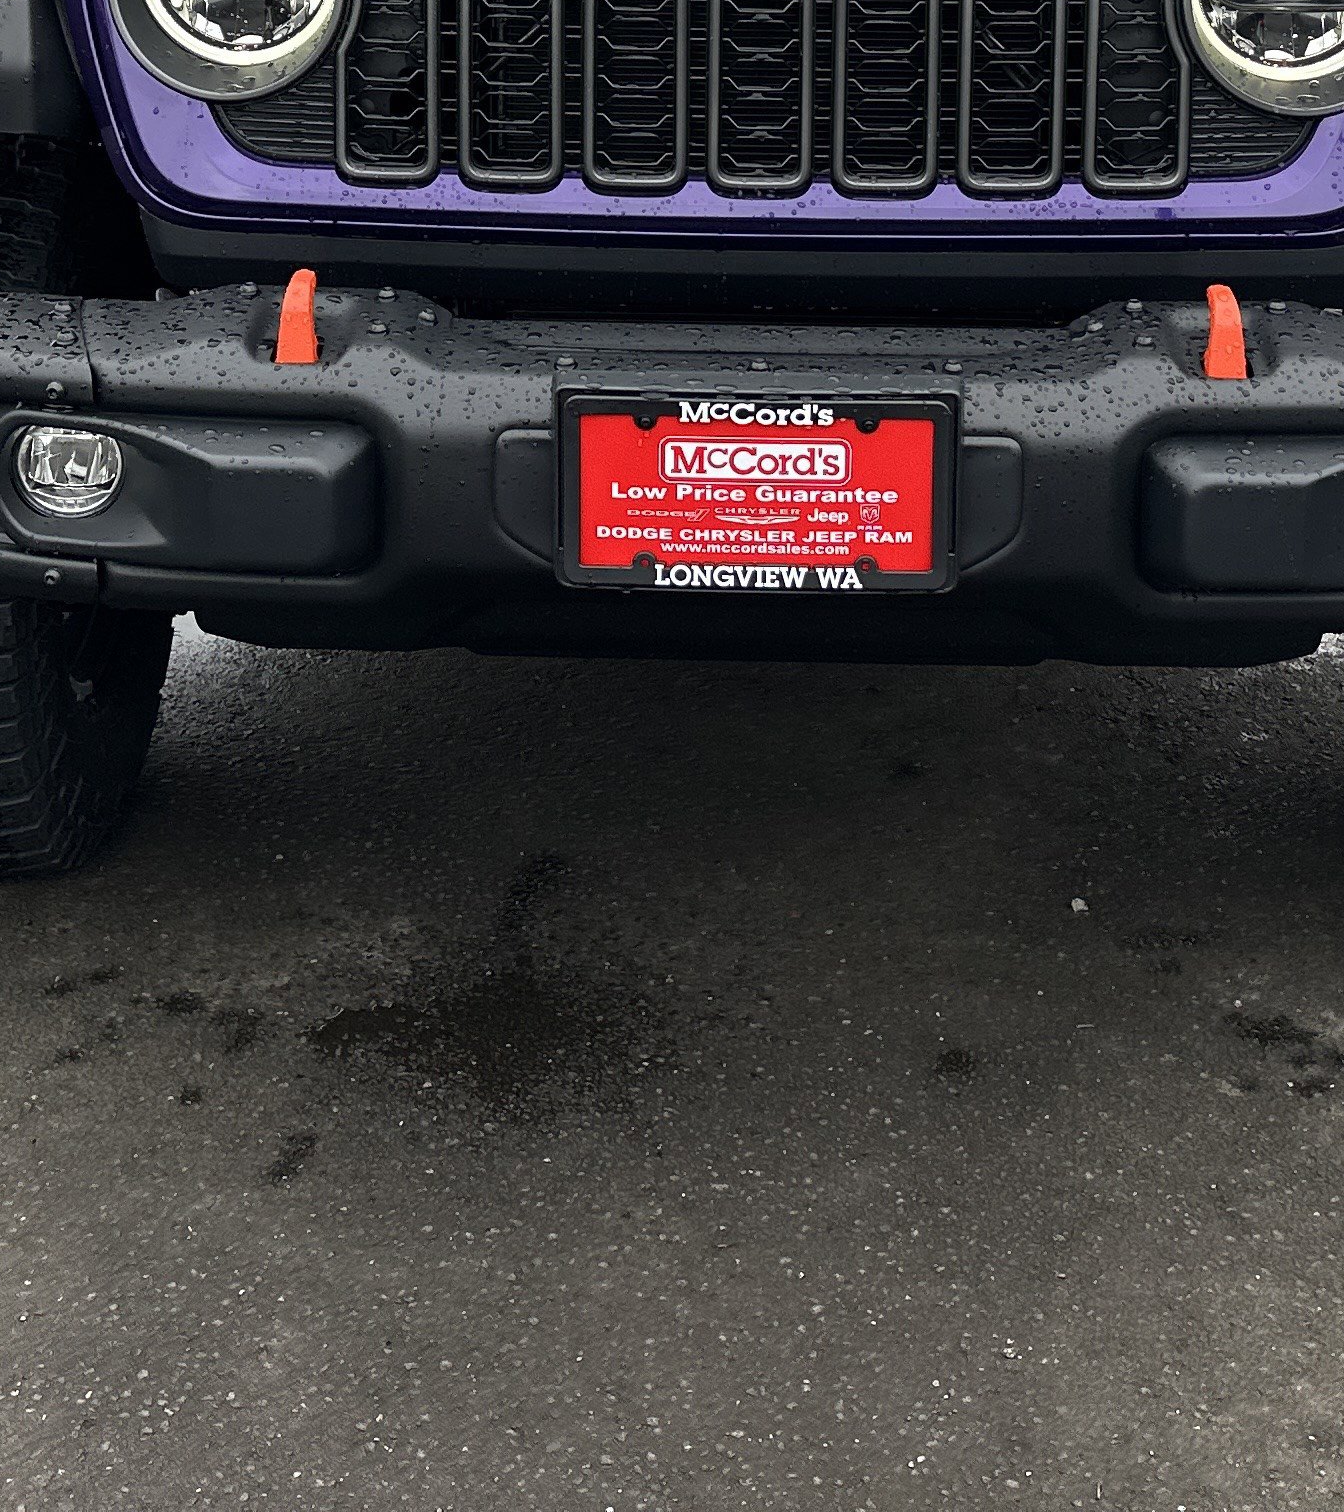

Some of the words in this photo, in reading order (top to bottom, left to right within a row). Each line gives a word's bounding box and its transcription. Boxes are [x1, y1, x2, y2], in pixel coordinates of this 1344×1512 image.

[678, 401, 834, 425] McCord's
[670, 445, 840, 475] McCord's
[611, 481, 667, 500] Low
[676, 484, 746, 501] Price
[755, 485, 899, 503] Guarantee
[713, 507, 802, 515] CHRYSLER
[807, 508, 849, 525] Jeep
[596, 525, 673, 540] DODGE
[679, 528, 796, 543] CHRYSLER
[802, 530, 858, 544] JEEP
[864, 531, 913, 544] RAM
[660, 542, 850, 556] www.mccordsales.com
[654, 563, 808, 588] LONGVIEW
[816, 567, 863, 589] WA
